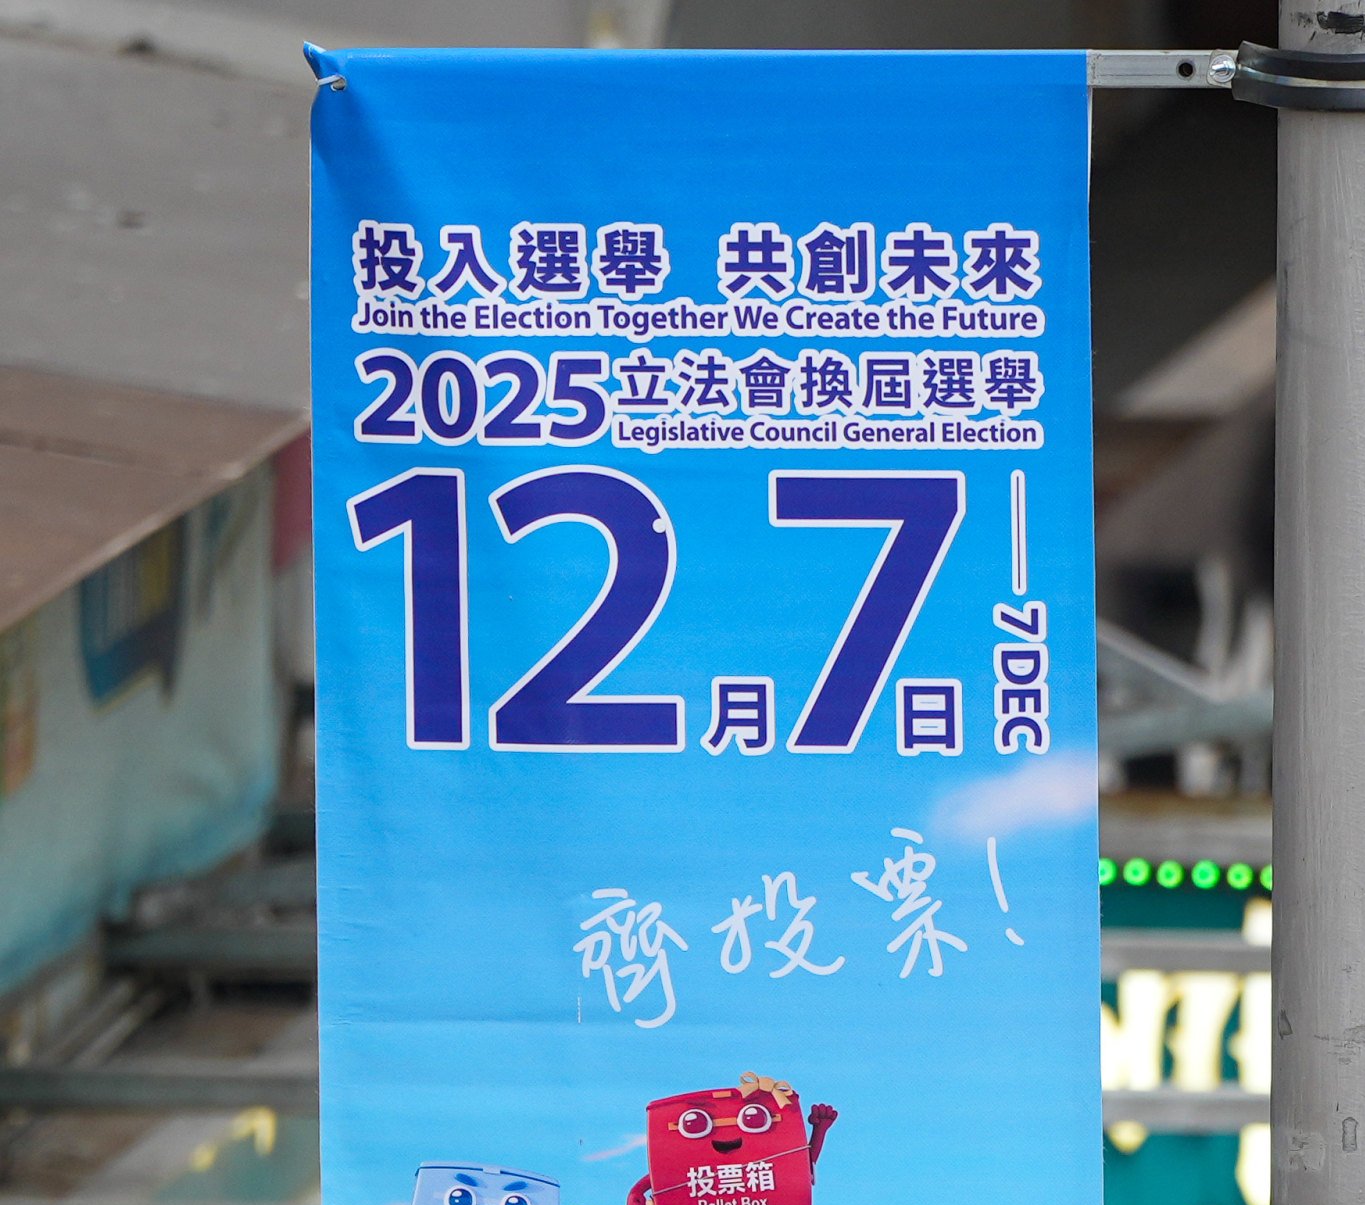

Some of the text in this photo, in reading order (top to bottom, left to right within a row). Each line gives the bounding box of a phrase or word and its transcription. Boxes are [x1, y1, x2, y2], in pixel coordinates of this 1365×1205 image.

[355, 225, 1033, 300] 投入選舉 共創未來
[355, 301, 1038, 336] Join the Election Together We Create the Future
[361, 352, 1036, 440] 2025 立法會換屆選舉
[618, 420, 1037, 447] Legislative Council General Election
[1000, 608, 1043, 748] 7 DEC
[686, 1161, 776, 1198] 投票箱
